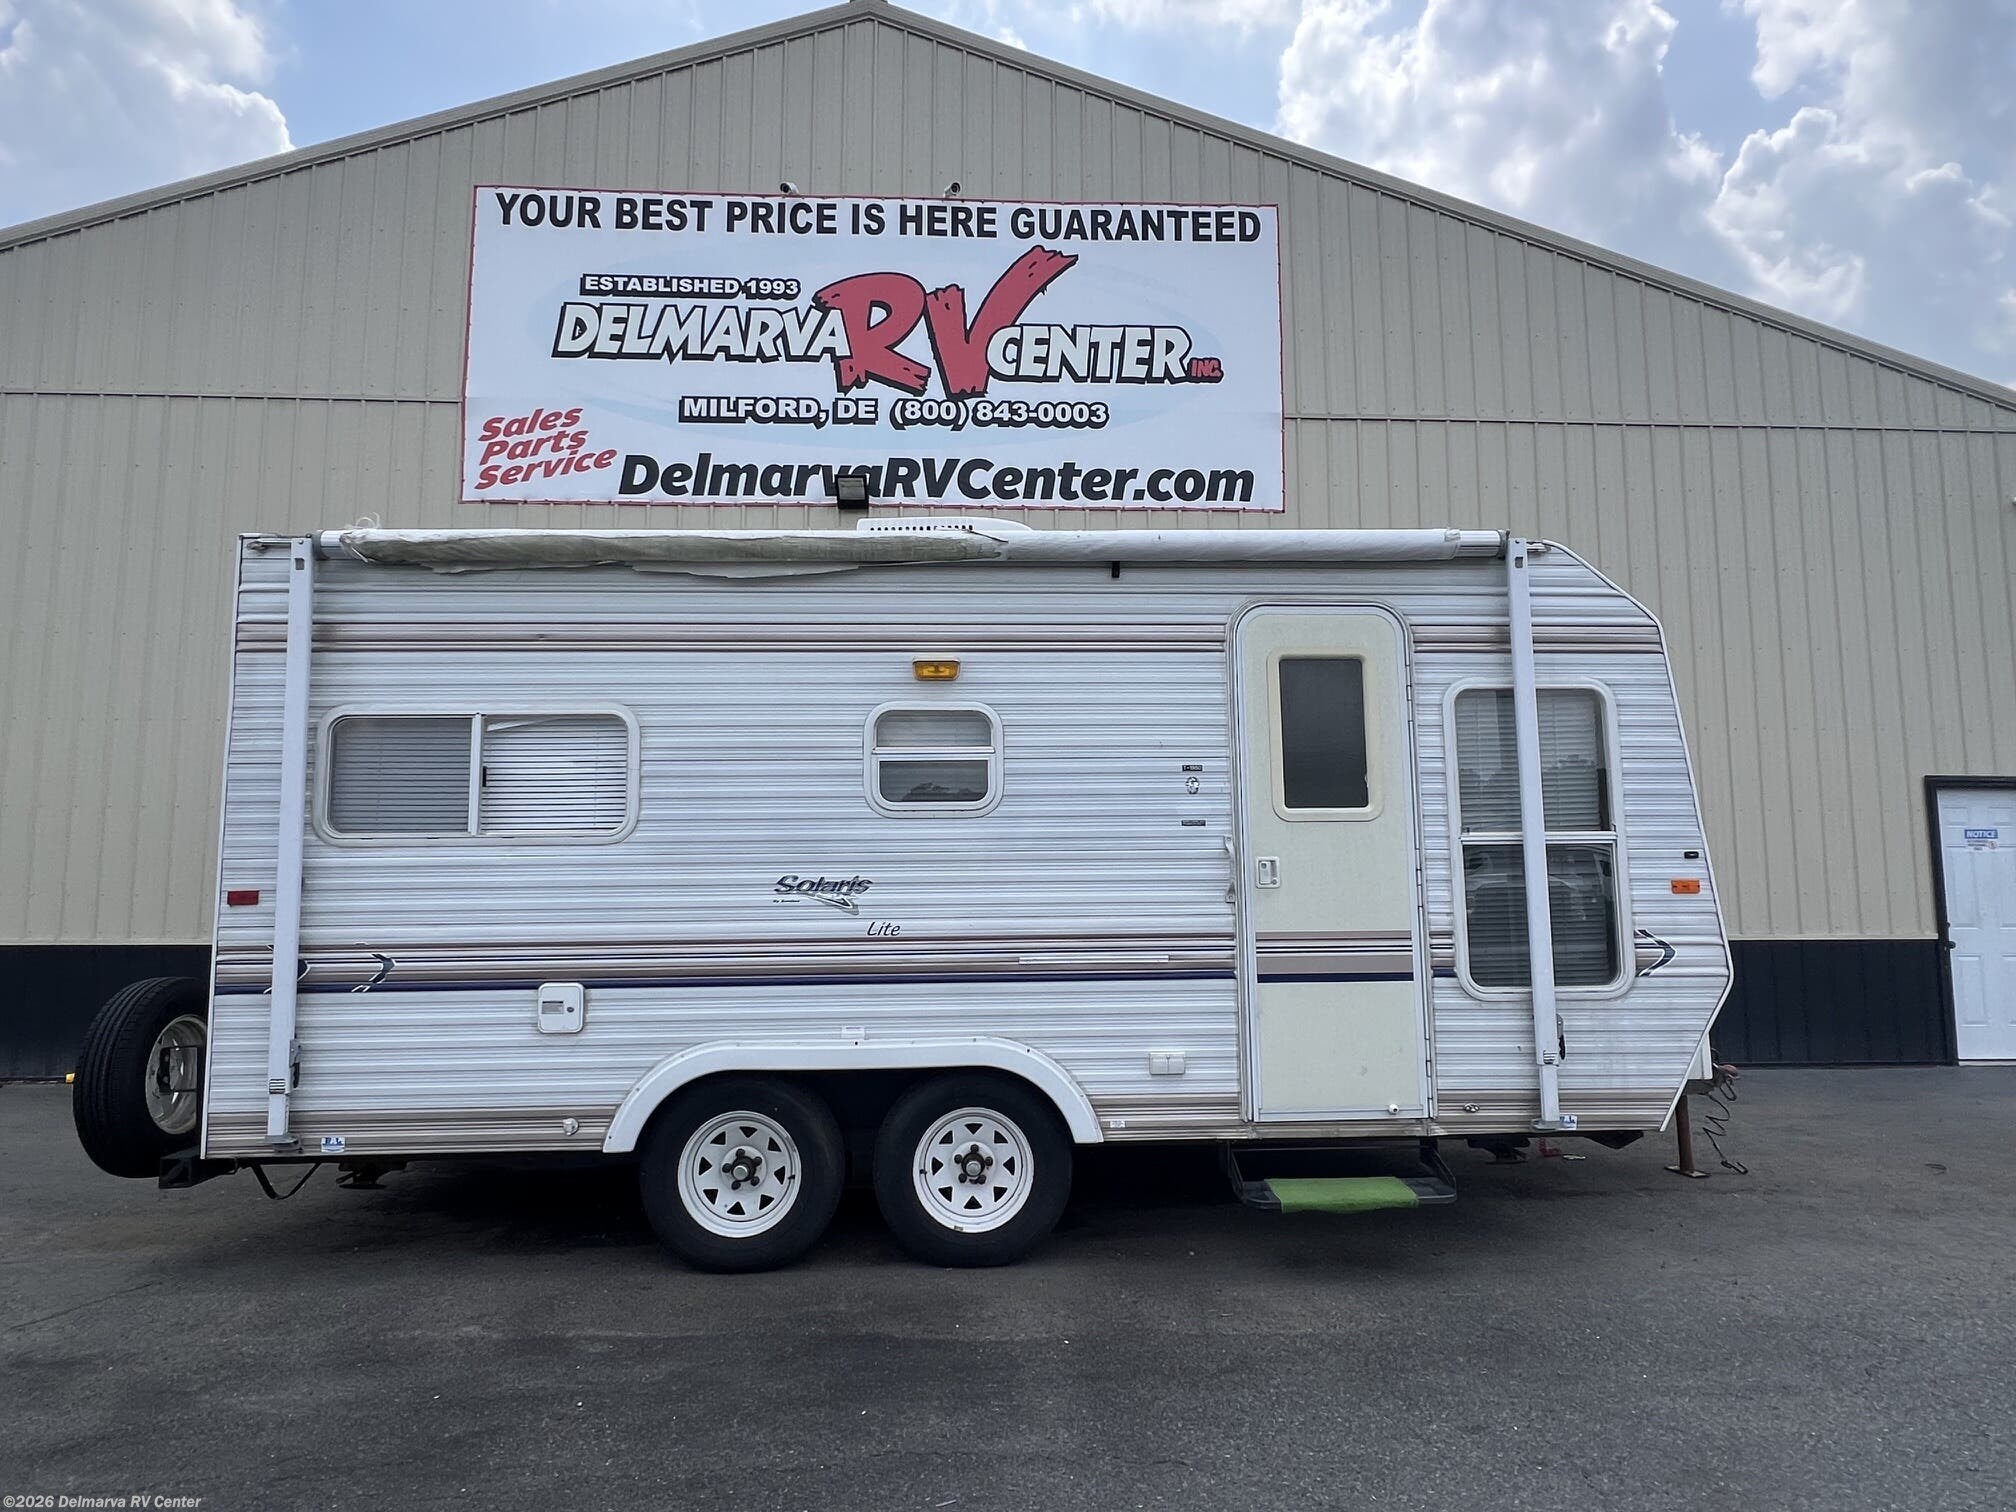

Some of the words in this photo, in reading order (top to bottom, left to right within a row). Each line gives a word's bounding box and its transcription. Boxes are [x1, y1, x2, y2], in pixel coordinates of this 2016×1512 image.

[496, 192, 601, 229] YOUR
[615, 197, 713, 232] BEST
[726, 200, 837, 235] PRICE
[852, 203, 886, 236] IS
[900, 204, 998, 239] HERE
[1010, 207, 1261, 242] GUARANTEED
[583, 275, 741, 297] ESTABLISHED
[744, 278, 800, 299] 1993
[552, 302, 852, 364] DELMARVA
[812, 245, 1079, 399] RV
[986, 323, 1193, 384] CENTER
[478, 407, 583, 442] Sales
[680, 397, 829, 428] MILFORD,
[833, 399, 878, 425] DE
[890, 400, 968, 430] (800)
[974, 401, 1109, 428] 843-0003
[479, 429, 588, 466] Parts
[474, 448, 617, 490] Service
[1966, 830, 1996, 838] NOTICE
[773, 875, 873, 897] Solaris
[867, 922, 900, 936] Lite
